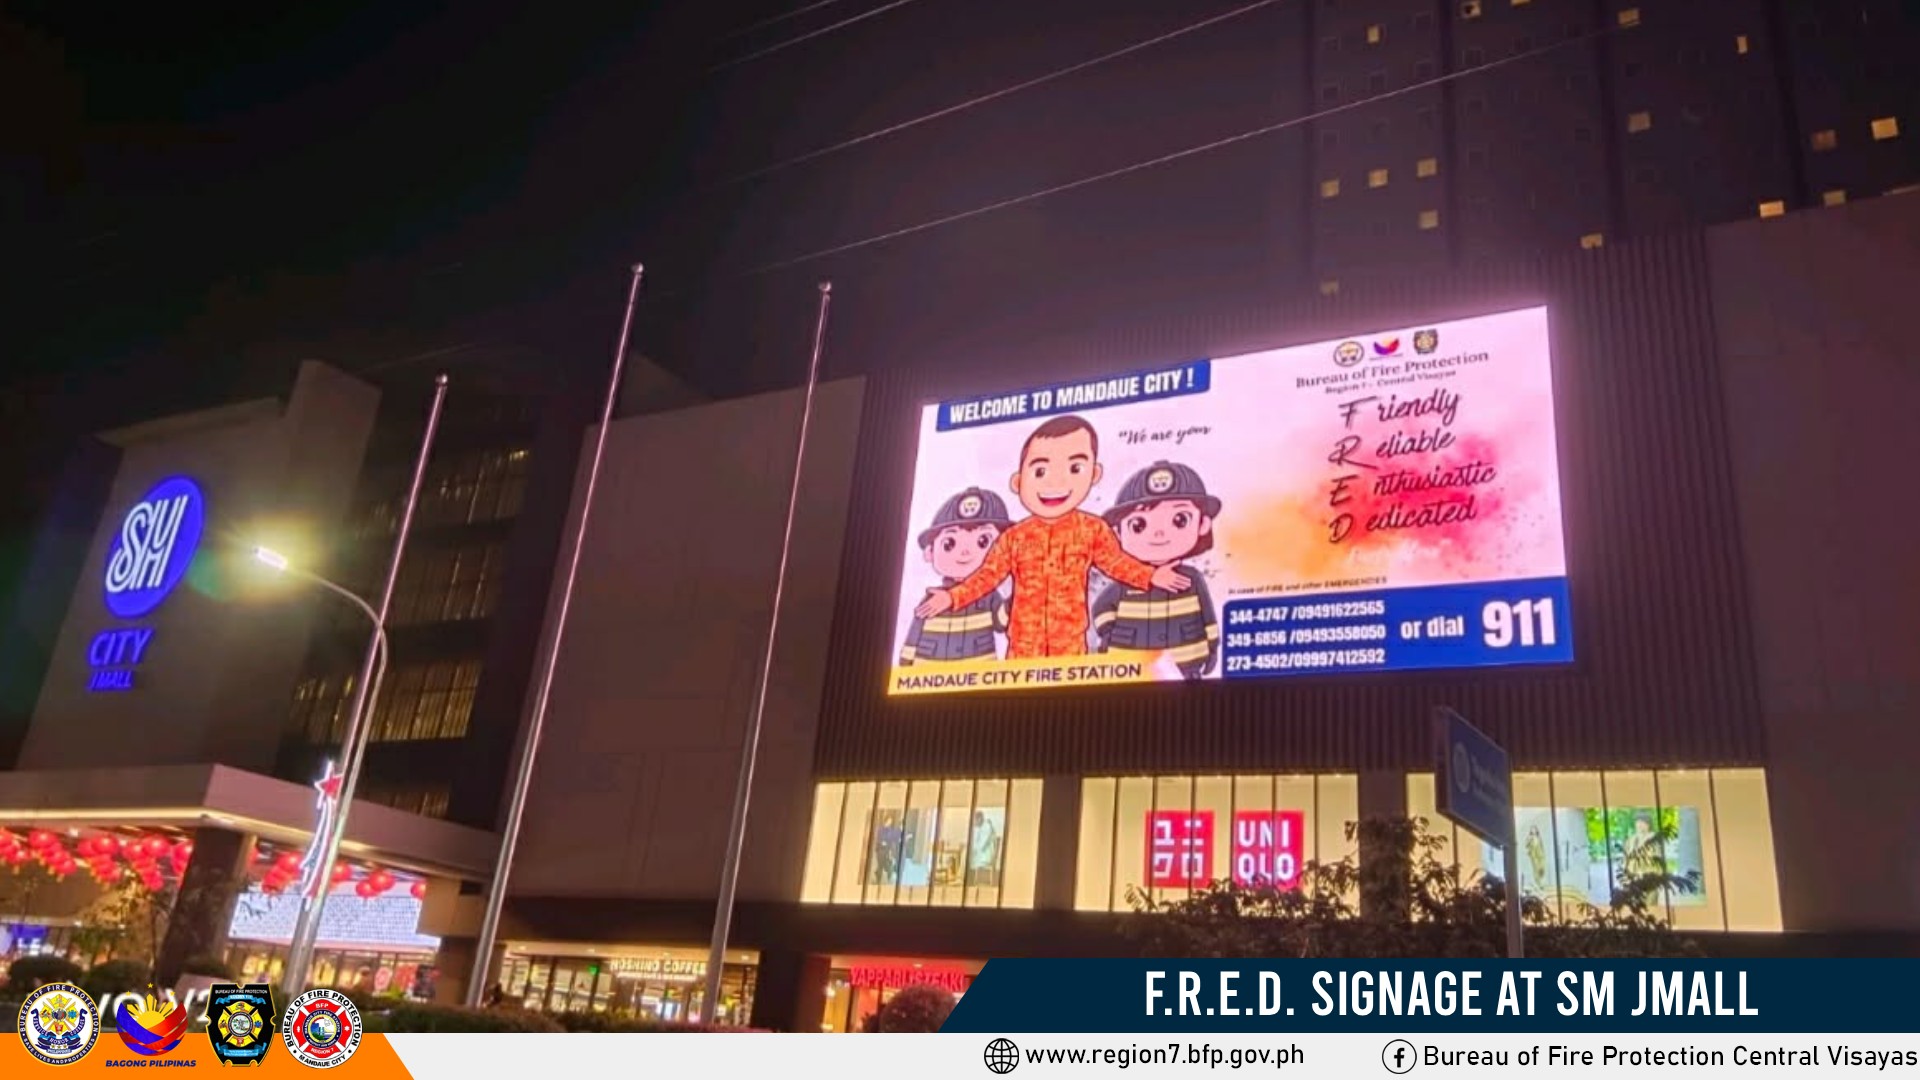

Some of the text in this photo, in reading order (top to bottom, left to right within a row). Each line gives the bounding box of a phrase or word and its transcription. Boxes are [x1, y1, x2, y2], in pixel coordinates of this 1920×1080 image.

[1296, 370, 1349, 389] Bureau
[1352, 366, 1370, 380] of
[1371, 364, 1400, 377] Fire
[1404, 351, 1489, 372] Protection
[950, 395, 1027, 424] WELCOME
[1032, 391, 1052, 412] TO
[1056, 376, 1140, 407] MANDAUE
[1143, 369, 1183, 394] CITY
[1150, 430, 1172, 441] are
[1175, 426, 1212, 446] your
[1230, 606, 1288, 624] 344-4747
[1400, 597, 1556, 648] or dial 911
[90, 629, 152, 666] CITY
[897, 664, 1142, 690] MANDAUE CITY FIRE STATION
[1237, 819, 1290, 848] UNI
[1237, 852, 1295, 884] QLO
[663, 960, 707, 976] COFFEE
